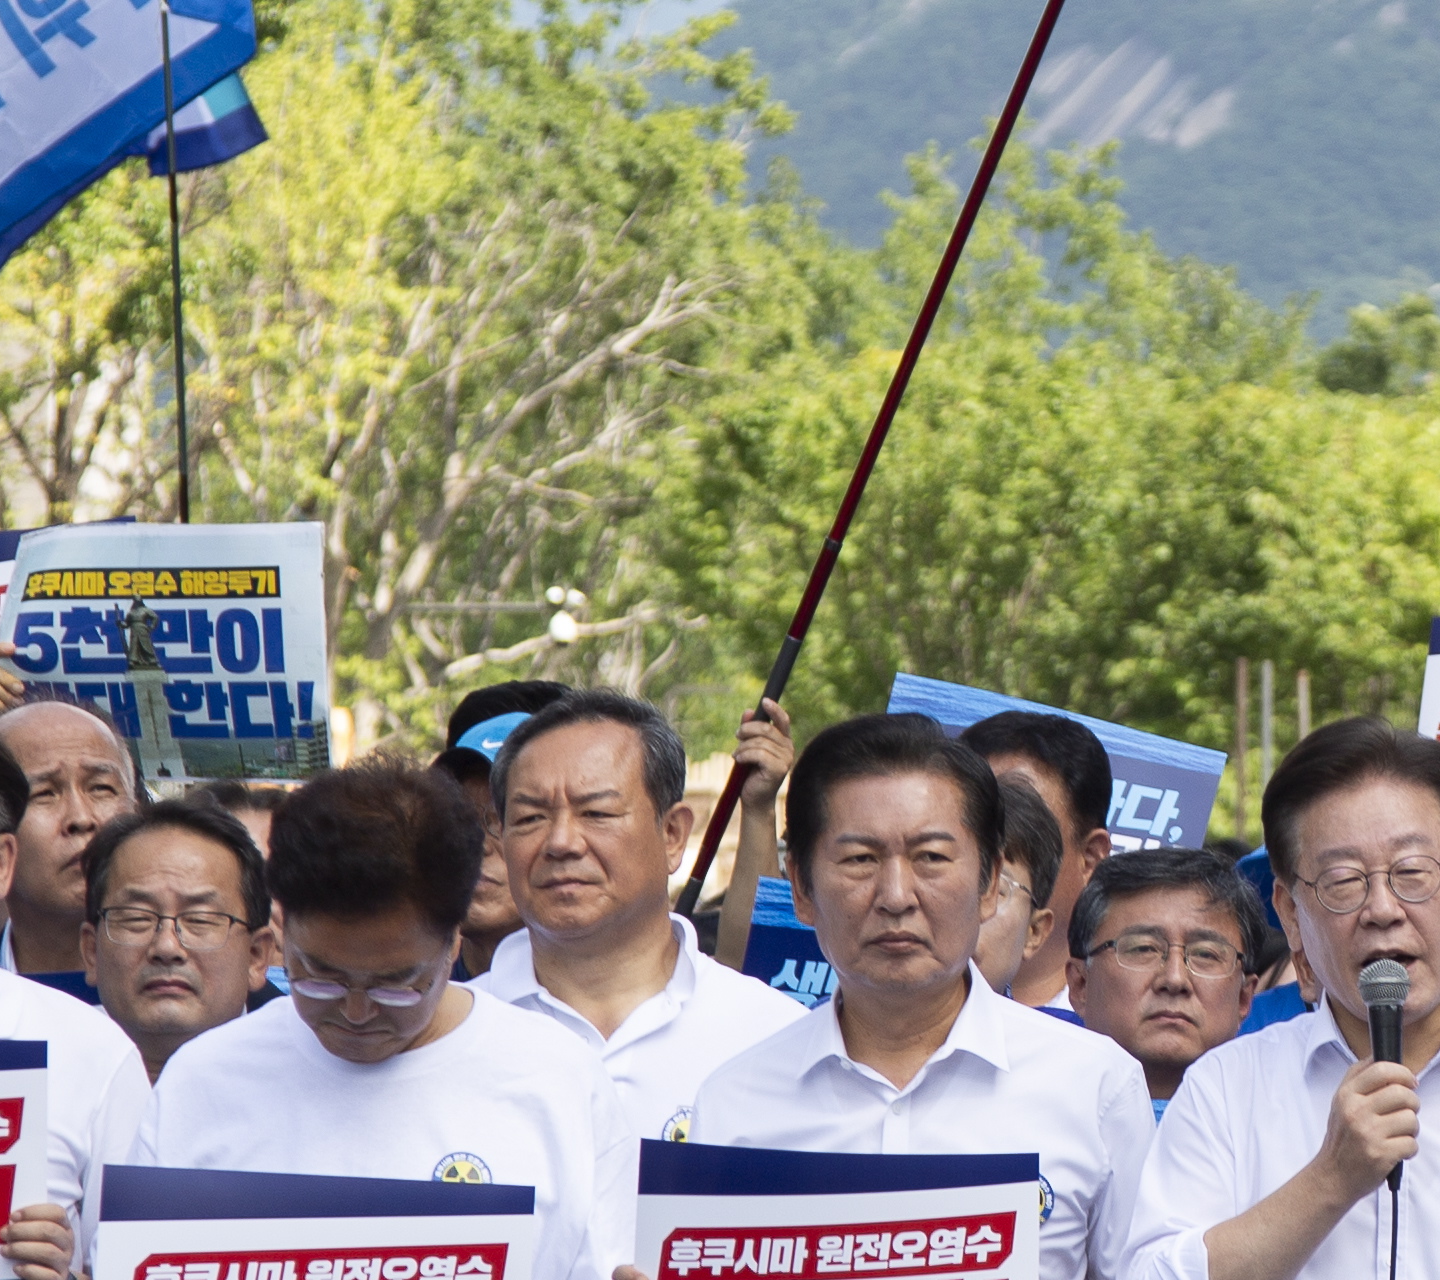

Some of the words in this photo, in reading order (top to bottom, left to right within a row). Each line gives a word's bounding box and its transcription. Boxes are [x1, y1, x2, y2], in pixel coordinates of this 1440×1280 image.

[26, 572, 106, 598] 후쿠시마
[108, 571, 176, 596] 오염수
[180, 569, 276, 594] 해양투기
[13, 607, 284, 674] 5천만이
[24, 681, 141, 738] 대
[164, 681, 315, 739] 한다!
[668, 1232, 809, 1276] 후쿠시마
[817, 1225, 1002, 1271] 원전오염수
